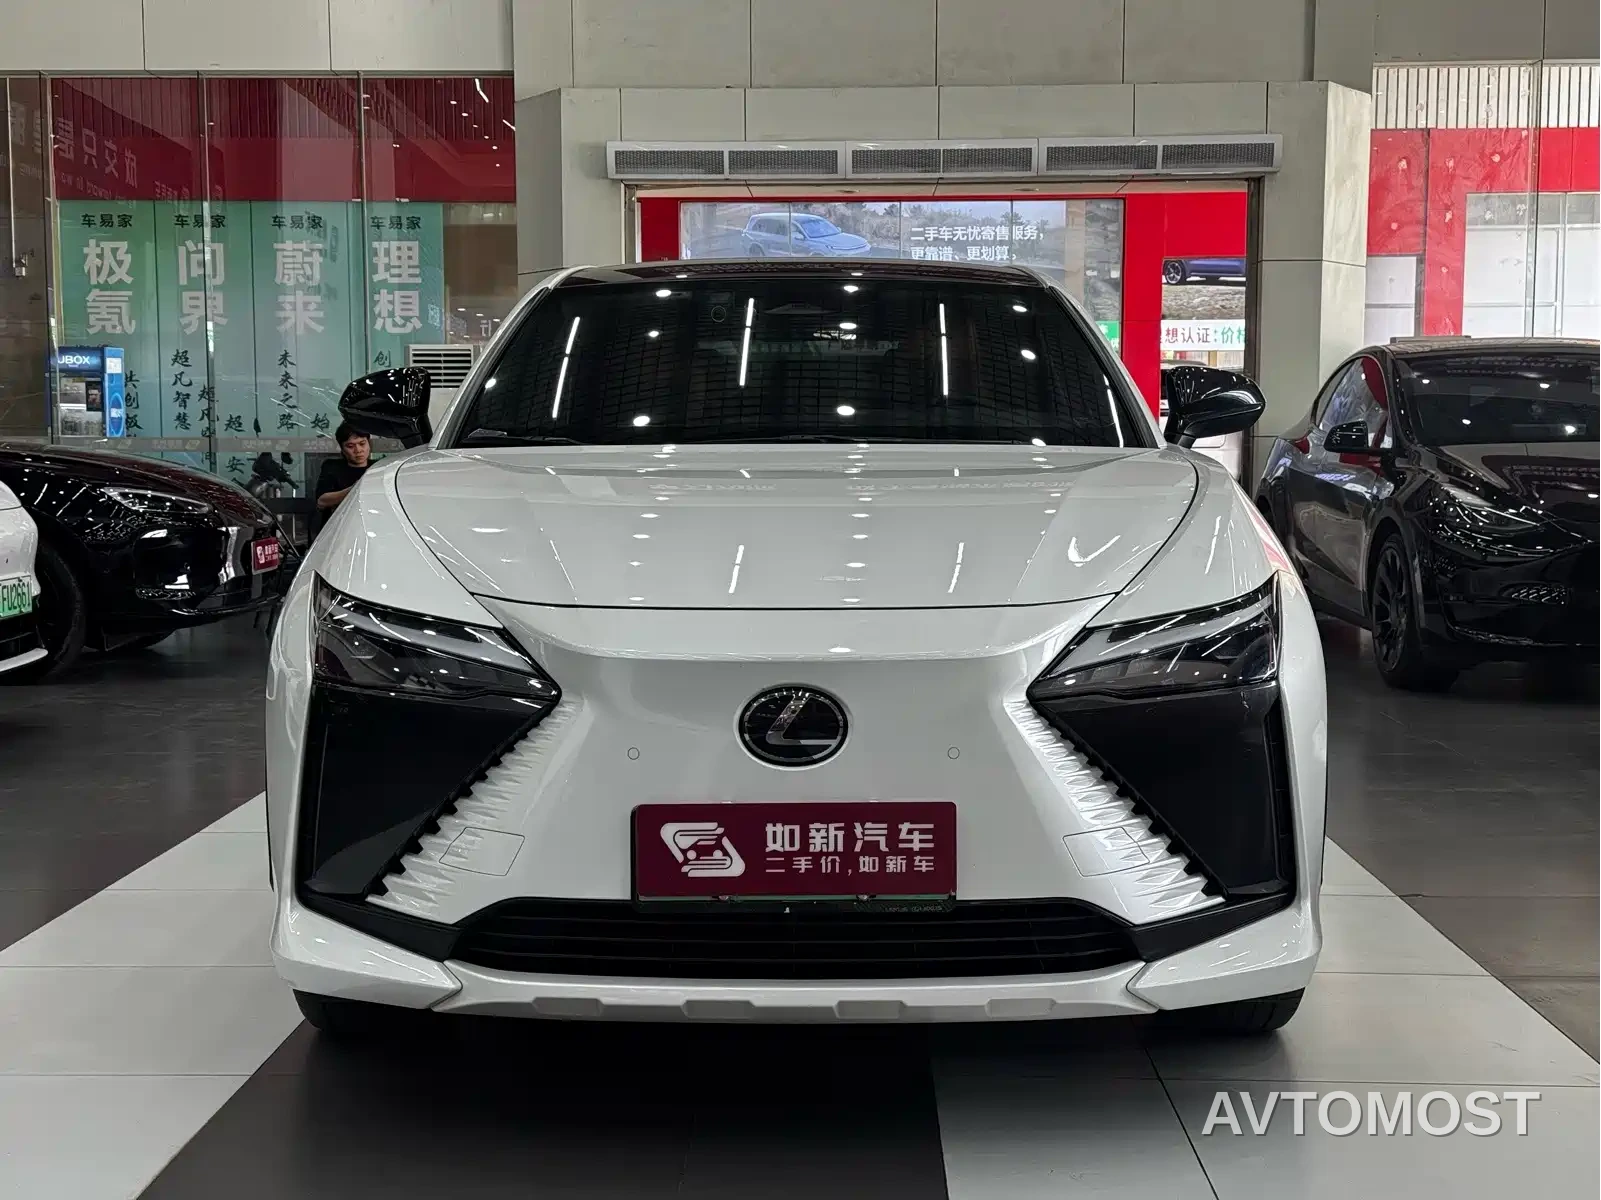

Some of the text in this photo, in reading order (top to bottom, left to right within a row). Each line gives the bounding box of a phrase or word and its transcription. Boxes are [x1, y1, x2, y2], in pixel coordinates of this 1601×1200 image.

[81, 213, 133, 228] 车易家
[174, 214, 226, 229] 车易家
[271, 215, 324, 230] 车易家
[370, 216, 423, 230] 车易家
[910, 225, 1045, 241] 二手车无忧寄售服务，
[910, 246, 1017, 261] 更靠谱、更划算，
[83, 239, 136, 335] 极氪
[178, 240, 229, 336] 问界
[273, 240, 325, 335] 蔚来
[371, 240, 423, 334] 理想
[1160, 326, 1245, 345] 想认证：价
[171, 349, 193, 430] 超凡智慧
[277, 350, 299, 430] 未来之路
[765, 822, 934, 853] 如新汽车
[765, 855, 935, 875] 二手价，如新车
